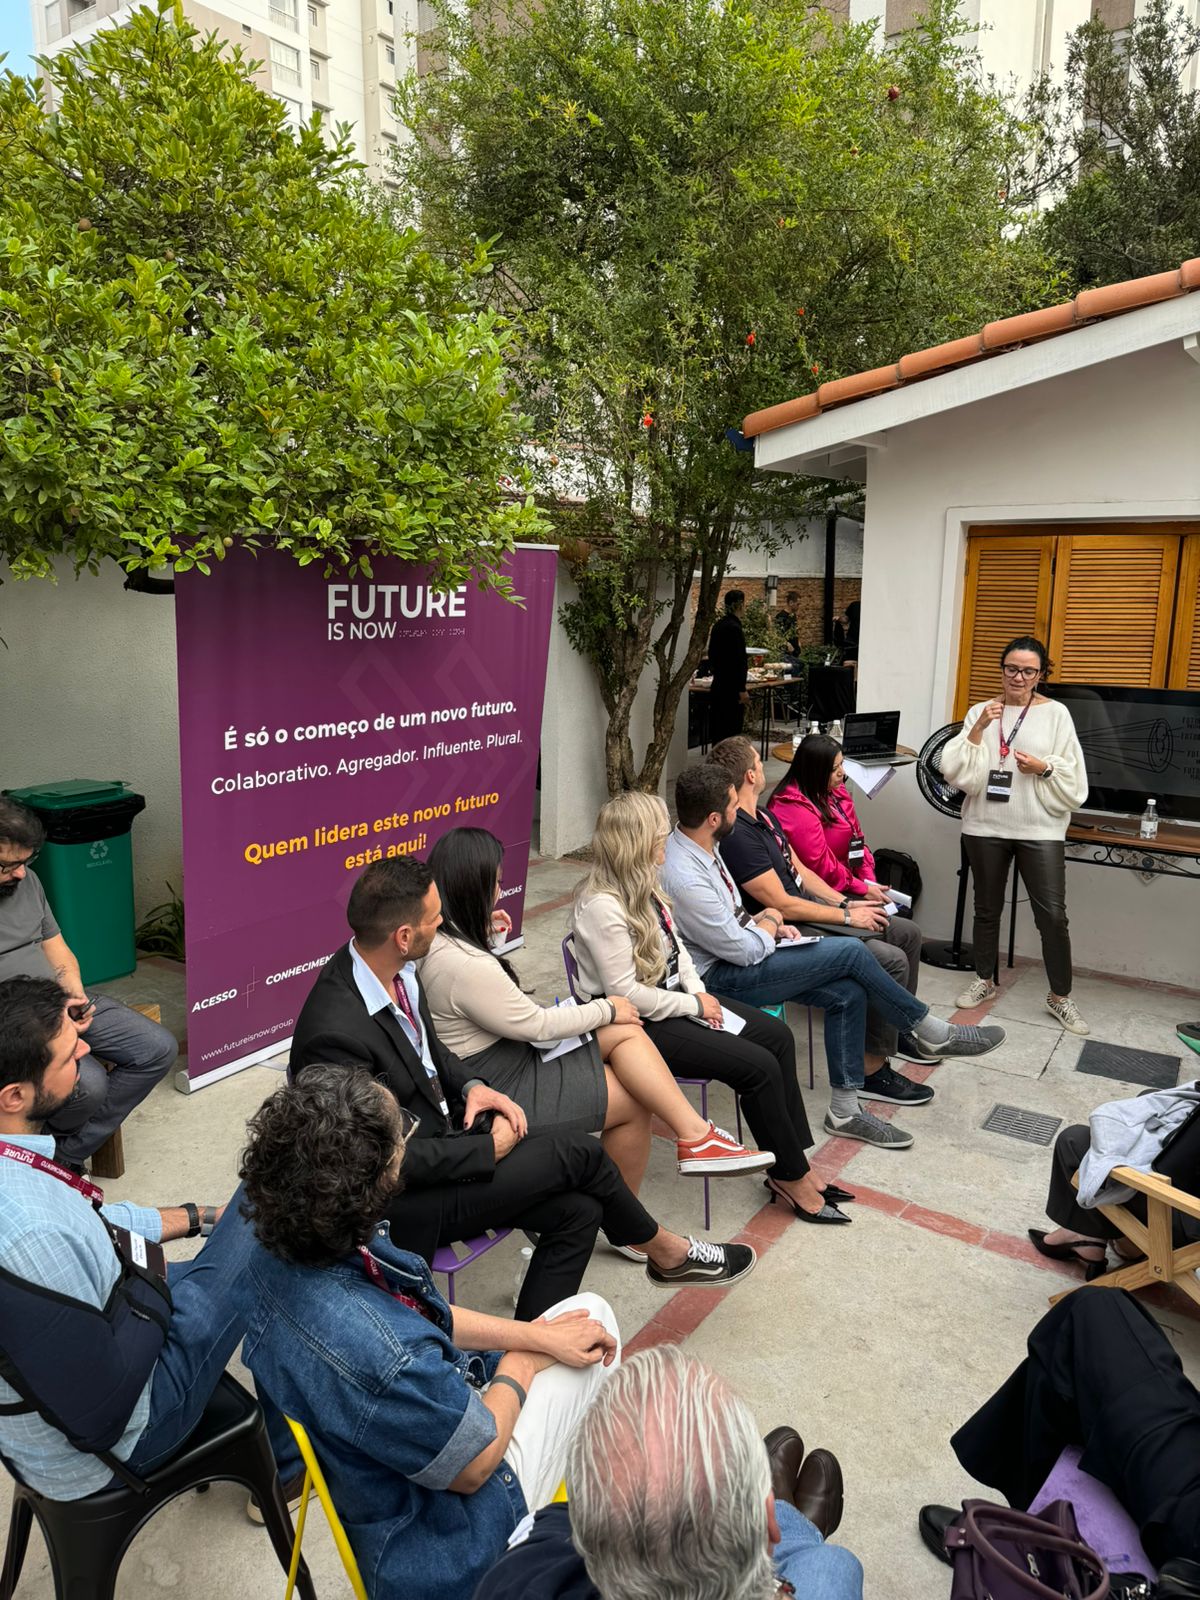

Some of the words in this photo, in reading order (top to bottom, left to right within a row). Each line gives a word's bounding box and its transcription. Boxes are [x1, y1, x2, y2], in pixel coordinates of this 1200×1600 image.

[327, 584, 466, 618] FUTURE
[327, 623, 345, 640] IS
[349, 621, 397, 640] NOW
[224, 726, 238, 749] É
[244, 727, 270, 747] só
[275, 728, 289, 743] o
[293, 719, 370, 741] começo
[373, 714, 395, 731] de
[399, 713, 426, 728] um
[430, 705, 467, 723] novo
[471, 700, 517, 719] futuro.
[211, 764, 332, 795] Colaborativo.
[336, 749, 419, 779] Agregador.
[423, 736, 484, 760] Influente.
[487, 729, 523, 748] Plural.
[244, 836, 308, 865] Quem
[314, 822, 369, 847] lidera
[373, 813, 409, 833] este
[413, 803, 451, 823] novo
[454, 792, 499, 814] futuro
[345, 845, 383, 870] está
[386, 833, 427, 859] aqui!
[191, 988, 238, 1013] ACESSO
[265, 953, 335, 985] CONHECIMEN
[200, 1018, 294, 1061] www.futureisnow.group
[3, 1147, 35, 1164] FUTURE
